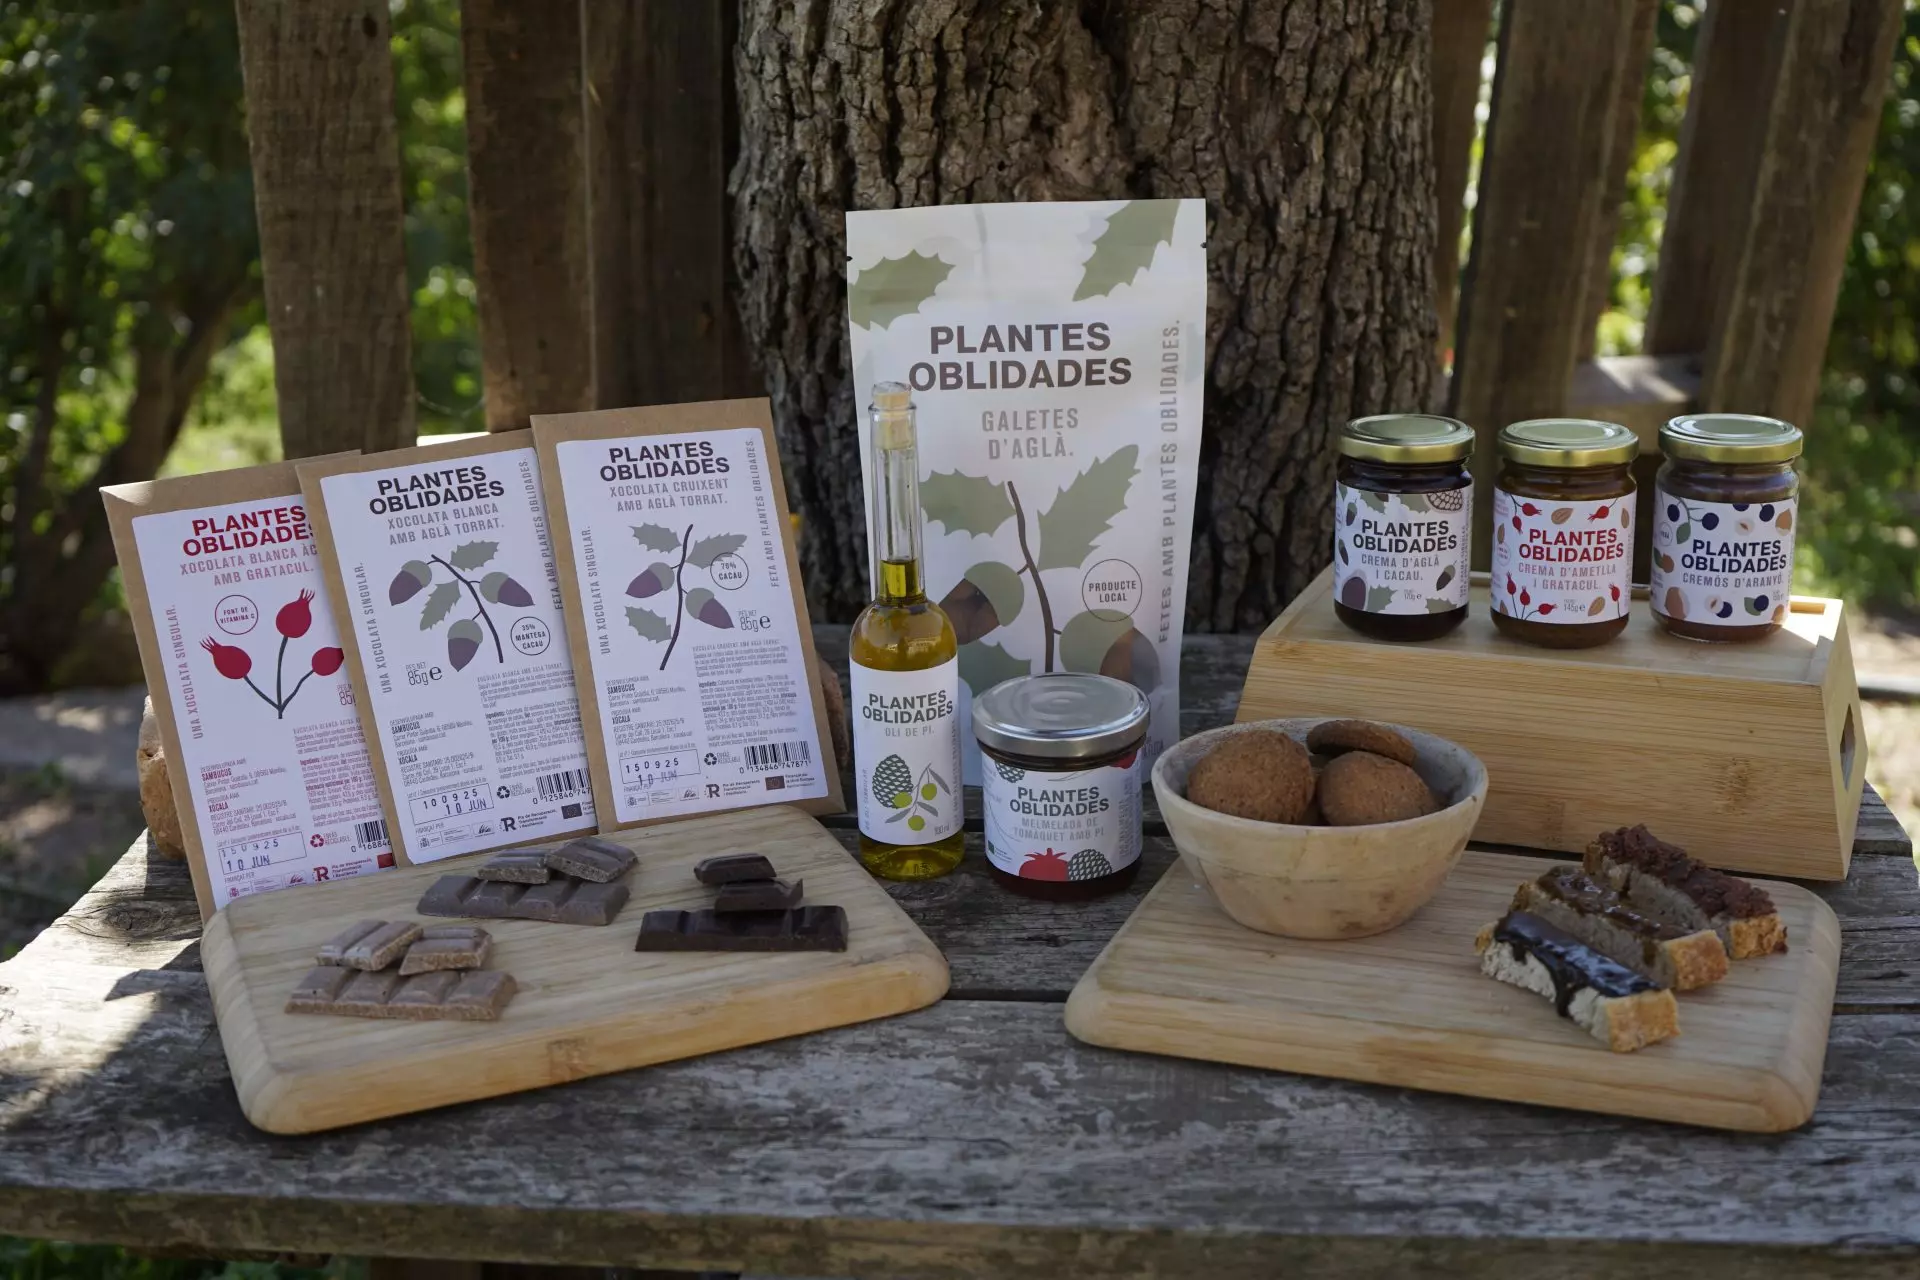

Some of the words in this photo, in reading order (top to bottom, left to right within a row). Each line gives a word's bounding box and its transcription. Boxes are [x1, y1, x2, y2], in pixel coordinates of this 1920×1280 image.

[930, 322, 1111, 354] PLANTES
[908, 357, 1132, 392] OBLIDADES
[1160, 319, 1180, 432] OBLIDADES.
[982, 407, 1079, 432] GALETES
[608, 441, 714, 464] PLANTES
[988, 431, 1074, 460] D'AGLÀ.
[600, 457, 730, 482] OBLIDADES
[377, 465, 487, 496] PLANTES
[518, 458, 540, 513] OBLIDADES.
[610, 482, 669, 498] XOCOLATA
[673, 478, 729, 493] CRUIXENT
[1160, 441, 1178, 527] PLANTES
[369, 480, 505, 515] OBLIDADES
[617, 500, 643, 512] AMB
[648, 494, 676, 509] AGLÀ
[680, 493, 728, 507] TORRAT.
[192, 505, 307, 537] PLANTES
[387, 511, 449, 530] XOCOLATA
[453, 502, 499, 519] BLANCA
[755, 496, 769, 536] PLANTES
[389, 531, 416, 546] AMB
[421, 523, 451, 540] AGLÀ
[454, 517, 505, 535] TORRAT.
[533, 516, 551, 558] PLANTES
[1362, 519, 1449, 537] PLANTES
[1529, 528, 1617, 546] PLANTES
[581, 525, 598, 577] SINGULAR.
[763, 540, 775, 561] AMB
[1353, 534, 1458, 553] OBLIDADES
[1519, 542, 1624, 562] OBLIDADES
[1693, 539, 1781, 557] PLANTES
[180, 555, 245, 576] XOCOLATA
[250, 547, 297, 565] BLANCA
[721, 562, 737, 570] 70%
[1162, 536, 1174, 577] AMB
[1361, 553, 1397, 568] CREMA
[1402, 554, 1440, 568] D'AGLÀ
[1681, 554, 1787, 573] OBLIDADES
[213, 569, 241, 587] AMB
[247, 561, 315, 581] GRATACUL.
[544, 562, 555, 582] AMB
[718, 571, 742, 580] CACAU
[767, 564, 780, 587] FETA
[1384, 570, 1424, 581] CACAU.
[1518, 562, 1554, 577] CREMA
[1560, 564, 1616, 577] D'AMETLLA
[354, 562, 374, 616] SINGULAR.
[1088, 580, 1137, 592] PRODUCTE
[1542, 580, 1601, 591] GRATACUL.
[1683, 572, 1729, 588] CREMÓS
[550, 587, 564, 610] FETA
[590, 581, 607, 631] XOCOLATA
[1099, 592, 1128, 603] LOCAL
[220, 614, 249, 624] VITAMINA
[223, 607, 239, 616] FONT
[1158, 585, 1172, 644] FETES
[166, 604, 186, 659] SINGULAR.
[515, 631, 546, 642] MANTEGA
[521, 623, 536, 631] 35%
[366, 618, 387, 669] XOCOLATA
[522, 640, 544, 650] CACAU
[598, 634, 611, 655] UNA
[178, 662, 199, 715] XOCOLATA
[380, 673, 393, 694] UNA
[869, 689, 946, 709] PLANTES
[863, 700, 953, 724] OBLIDADES
[190, 718, 204, 740] UNA
[885, 728, 900, 737] OLI
[905, 727, 918, 737] DE
[922, 725, 935, 736] PI.
[201, 768, 232, 781] SAMBUCUS
[638, 774, 654, 786] 10
[660, 770, 677, 783] JUN
[543, 791, 574, 803] 125846
[1017, 786, 1100, 803] PLANTES
[446, 802, 462, 815] 10
[469, 798, 487, 811] JUN
[1009, 798, 1110, 817] OBLIDADES
[1021, 817, 1082, 830] MELMELADA
[1086, 816, 1098, 827] DE
[1069, 831, 1091, 841] AMB
[227, 859, 244, 871] 10
[252, 855, 270, 868] JUN
